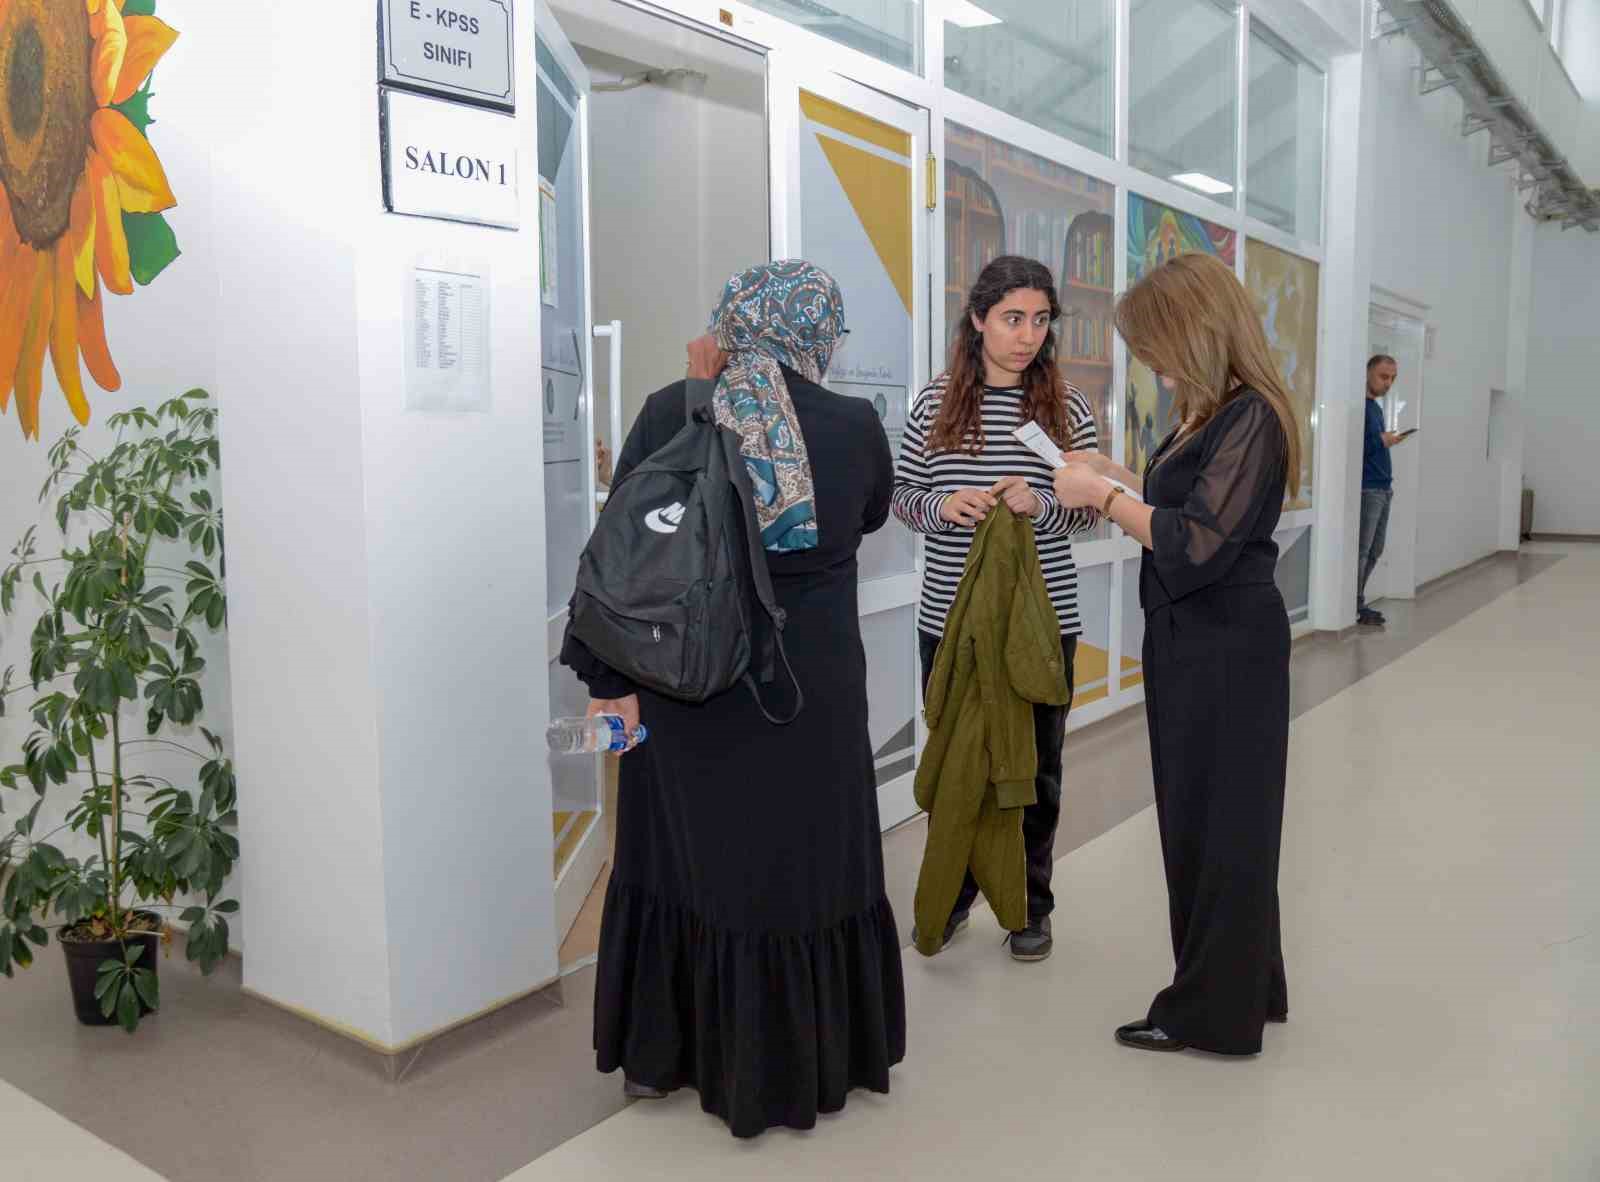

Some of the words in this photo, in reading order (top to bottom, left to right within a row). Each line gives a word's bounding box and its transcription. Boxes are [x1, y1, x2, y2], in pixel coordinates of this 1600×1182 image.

[410, 1, 421, 20] E
[436, 8, 480, 35] KPSS
[423, 42, 473, 69] SINIFI
[405, 145, 490, 182] SALON
[499, 163, 507, 185] 1
